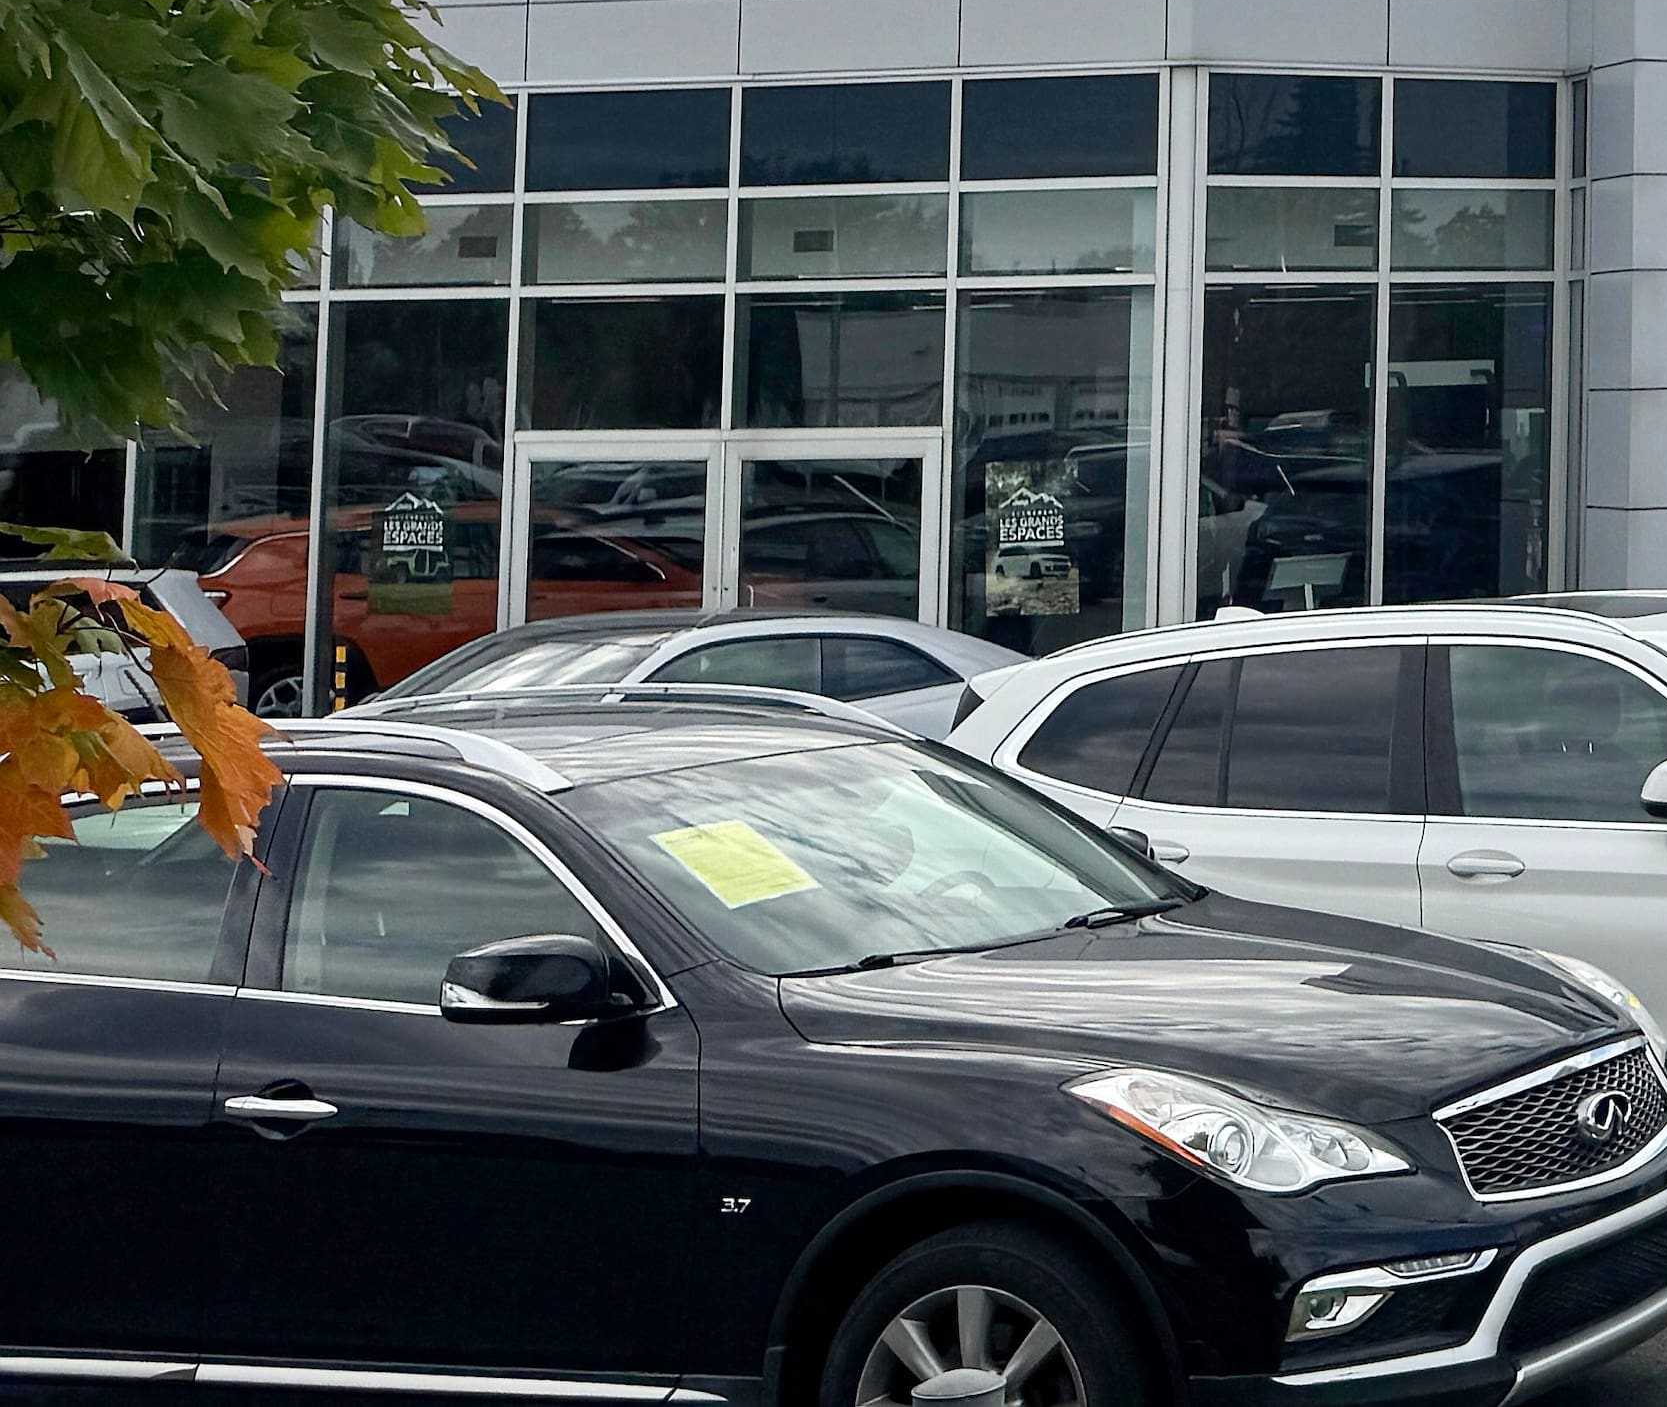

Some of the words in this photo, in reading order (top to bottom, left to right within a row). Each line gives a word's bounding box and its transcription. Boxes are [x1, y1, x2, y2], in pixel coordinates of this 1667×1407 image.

[383, 531, 443, 545] ESPACES
[999, 525, 1064, 542] ESPACES
[720, 1197, 752, 1213] 3.7
